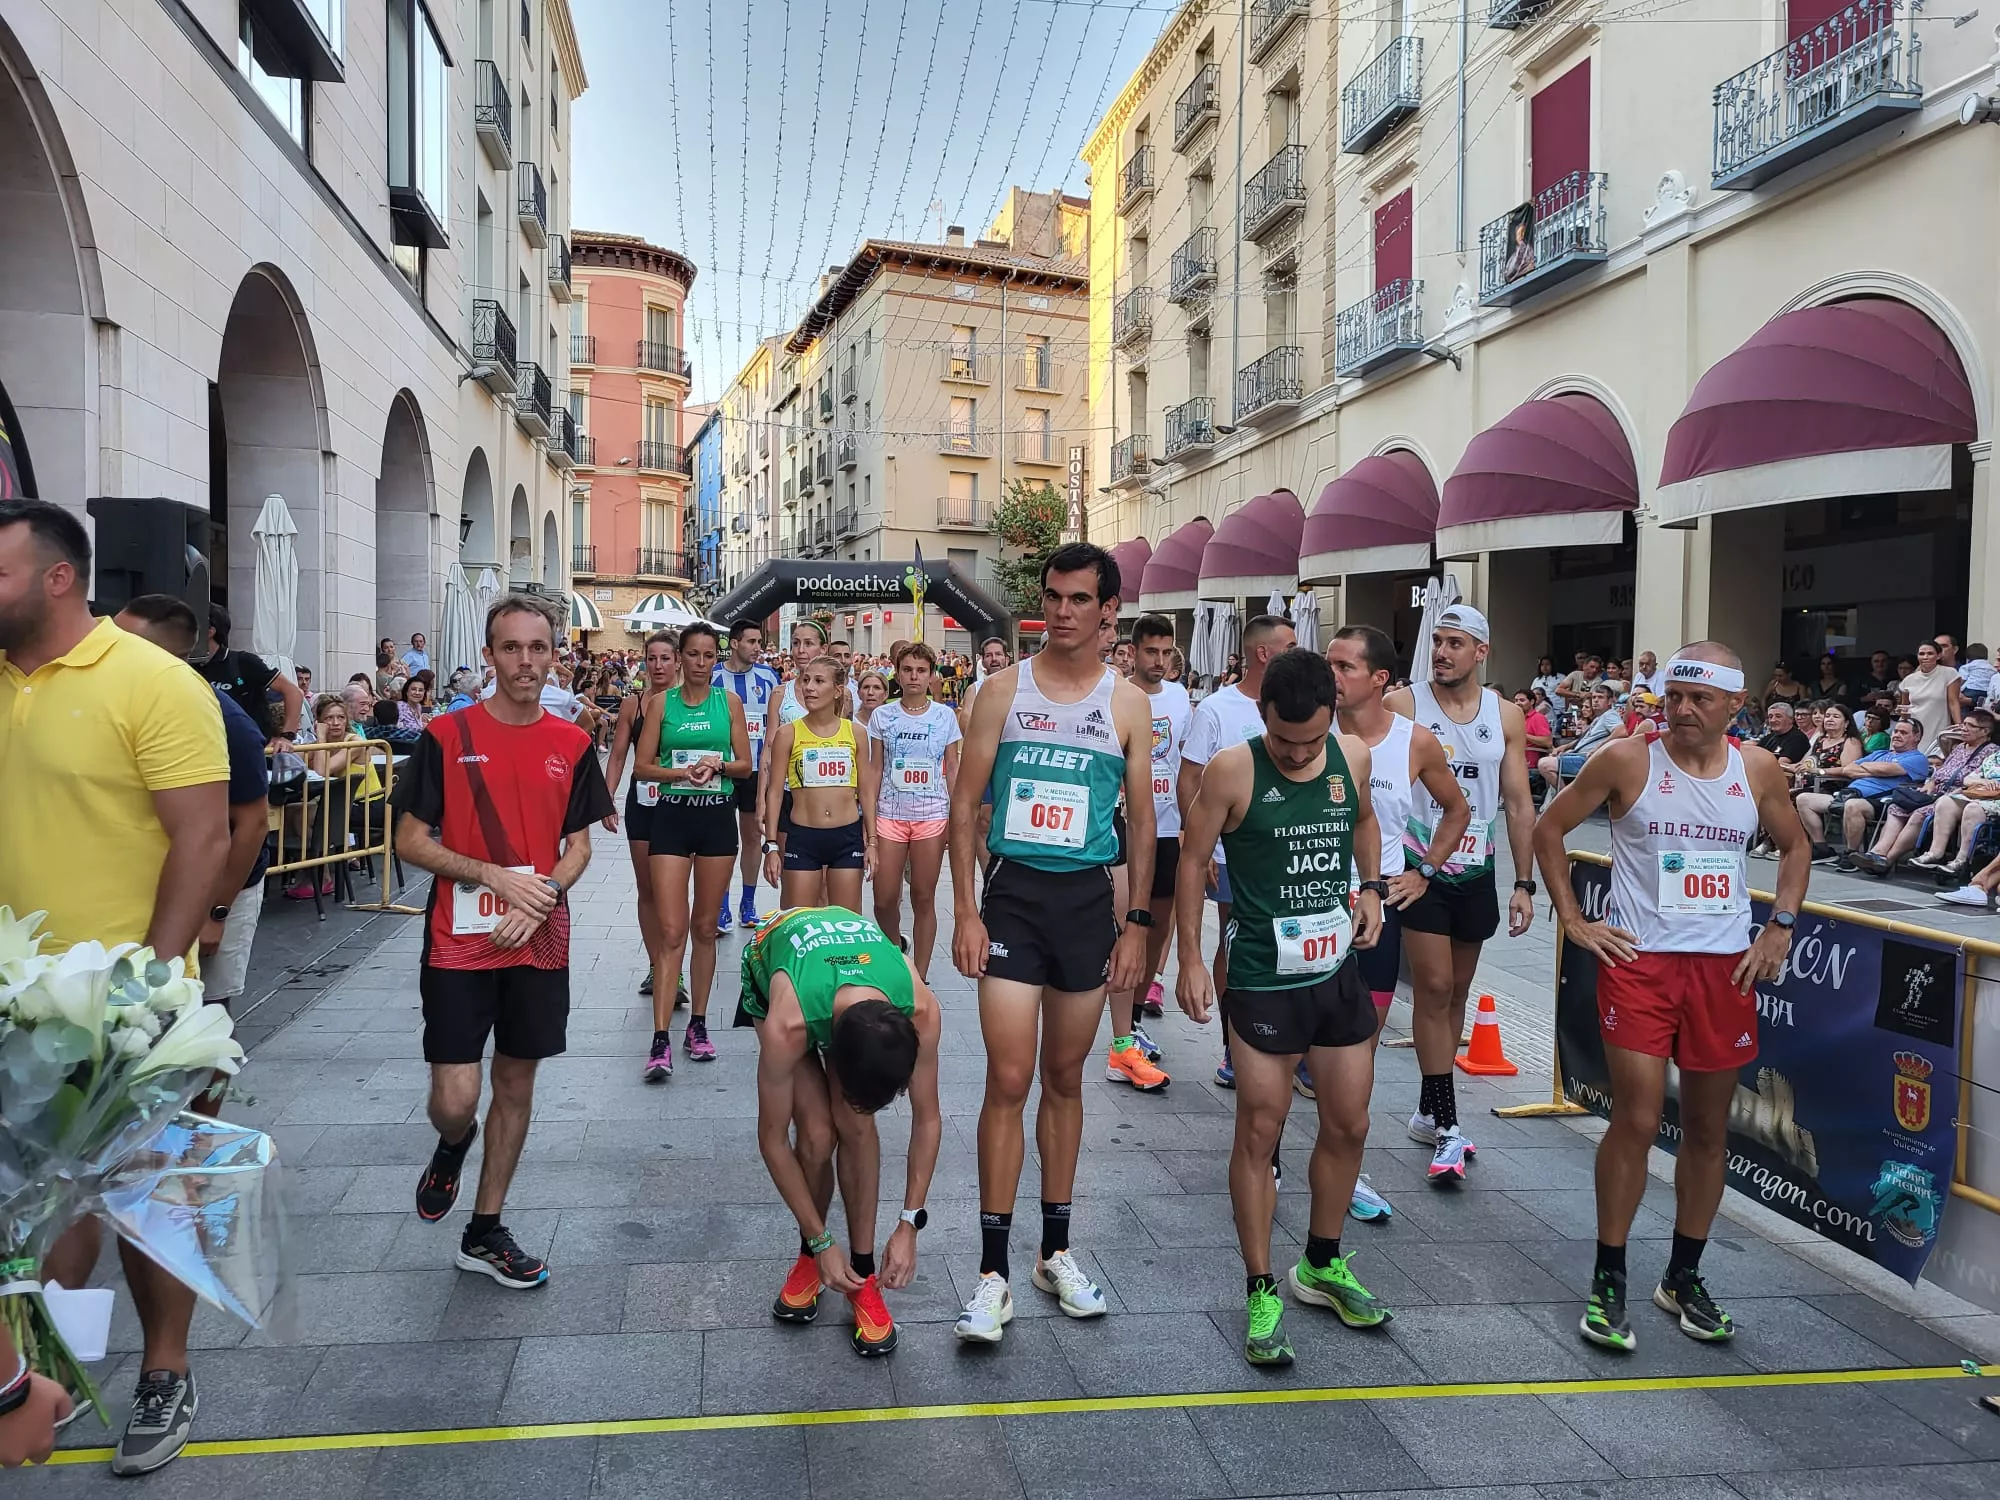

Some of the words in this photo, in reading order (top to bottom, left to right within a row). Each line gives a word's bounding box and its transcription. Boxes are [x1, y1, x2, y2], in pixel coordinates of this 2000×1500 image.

[1069, 447, 1081, 529] HOSTAL
[796, 574, 900, 596] podoactiva
[724, 609, 738, 620] Pisa
[1673, 664, 1704, 678] GMP
[1084, 716, 1105, 725] adidas
[896, 732, 929, 741] ATLEET
[1012, 745, 1094, 772] ATLEET
[818, 761, 846, 777] 085
[904, 770, 929, 784] 080
[1447, 763, 1479, 779] YB
[1049, 788, 1080, 798] MEDIEVAL
[1153, 778, 1170, 794] 60
[1262, 795, 1286, 803] adidas
[1030, 803, 1074, 831] 067
[1274, 819, 1350, 838] FLORISTERÍA
[1288, 841, 1305, 851] EL
[1306, 837, 1341, 850] CISNE
[1455, 835, 1477, 854] 72
[1286, 851, 1341, 875] JACA
[1279, 880, 1348, 899] Huesca
[1684, 873, 1730, 899] 063
[789, 920, 879, 950] ZOITI
[796, 933, 882, 959] ATLETISMO
[1303, 932, 1337, 962] 071
[1882, 1128, 1928, 1149] Ayuntamiento
[1928, 1145, 1936, 1153] de
[1893, 1139, 1924, 1156] Quicena
[1890, 1163, 1926, 1186] PIEDRA
[1892, 1177, 1932, 1200] PIEDRA
